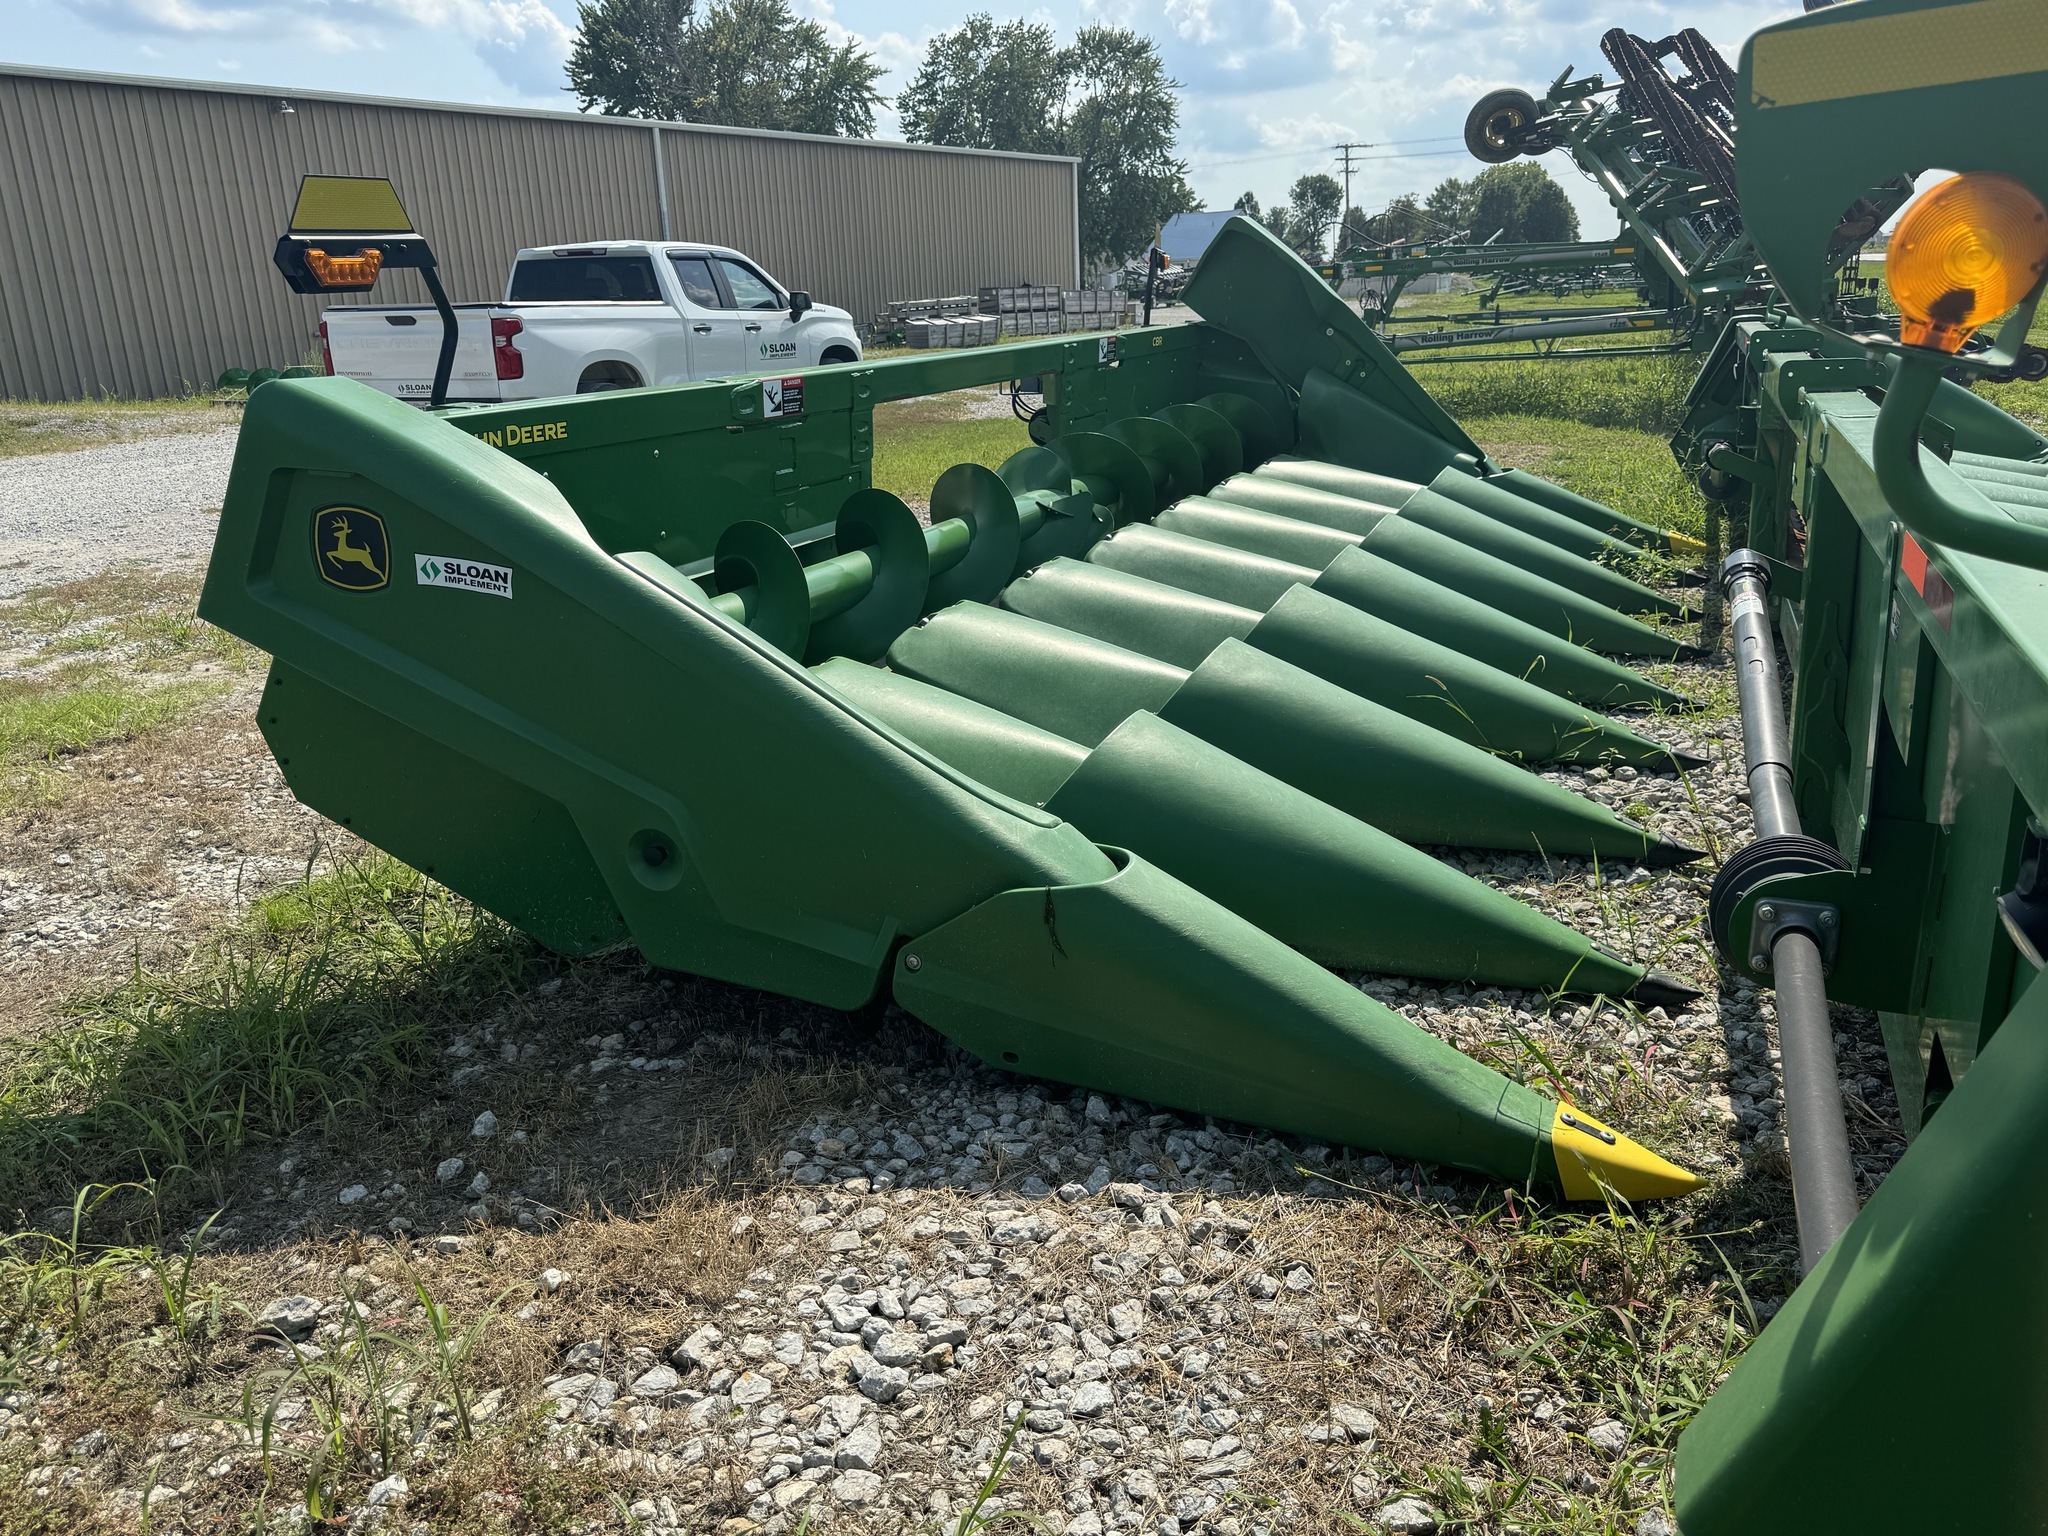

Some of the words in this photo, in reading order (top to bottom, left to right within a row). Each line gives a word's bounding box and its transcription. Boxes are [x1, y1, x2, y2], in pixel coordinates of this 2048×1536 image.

[1453, 258, 1479, 266] Rolling
[1421, 333, 1453, 343] Rolling
[1456, 330, 1493, 340] Harrow
[769, 342, 796, 353] SLOAN
[506, 421, 568, 446] DEERE
[443, 562, 508, 584] SLOAN
[444, 575, 508, 593] IMPLEMENT
